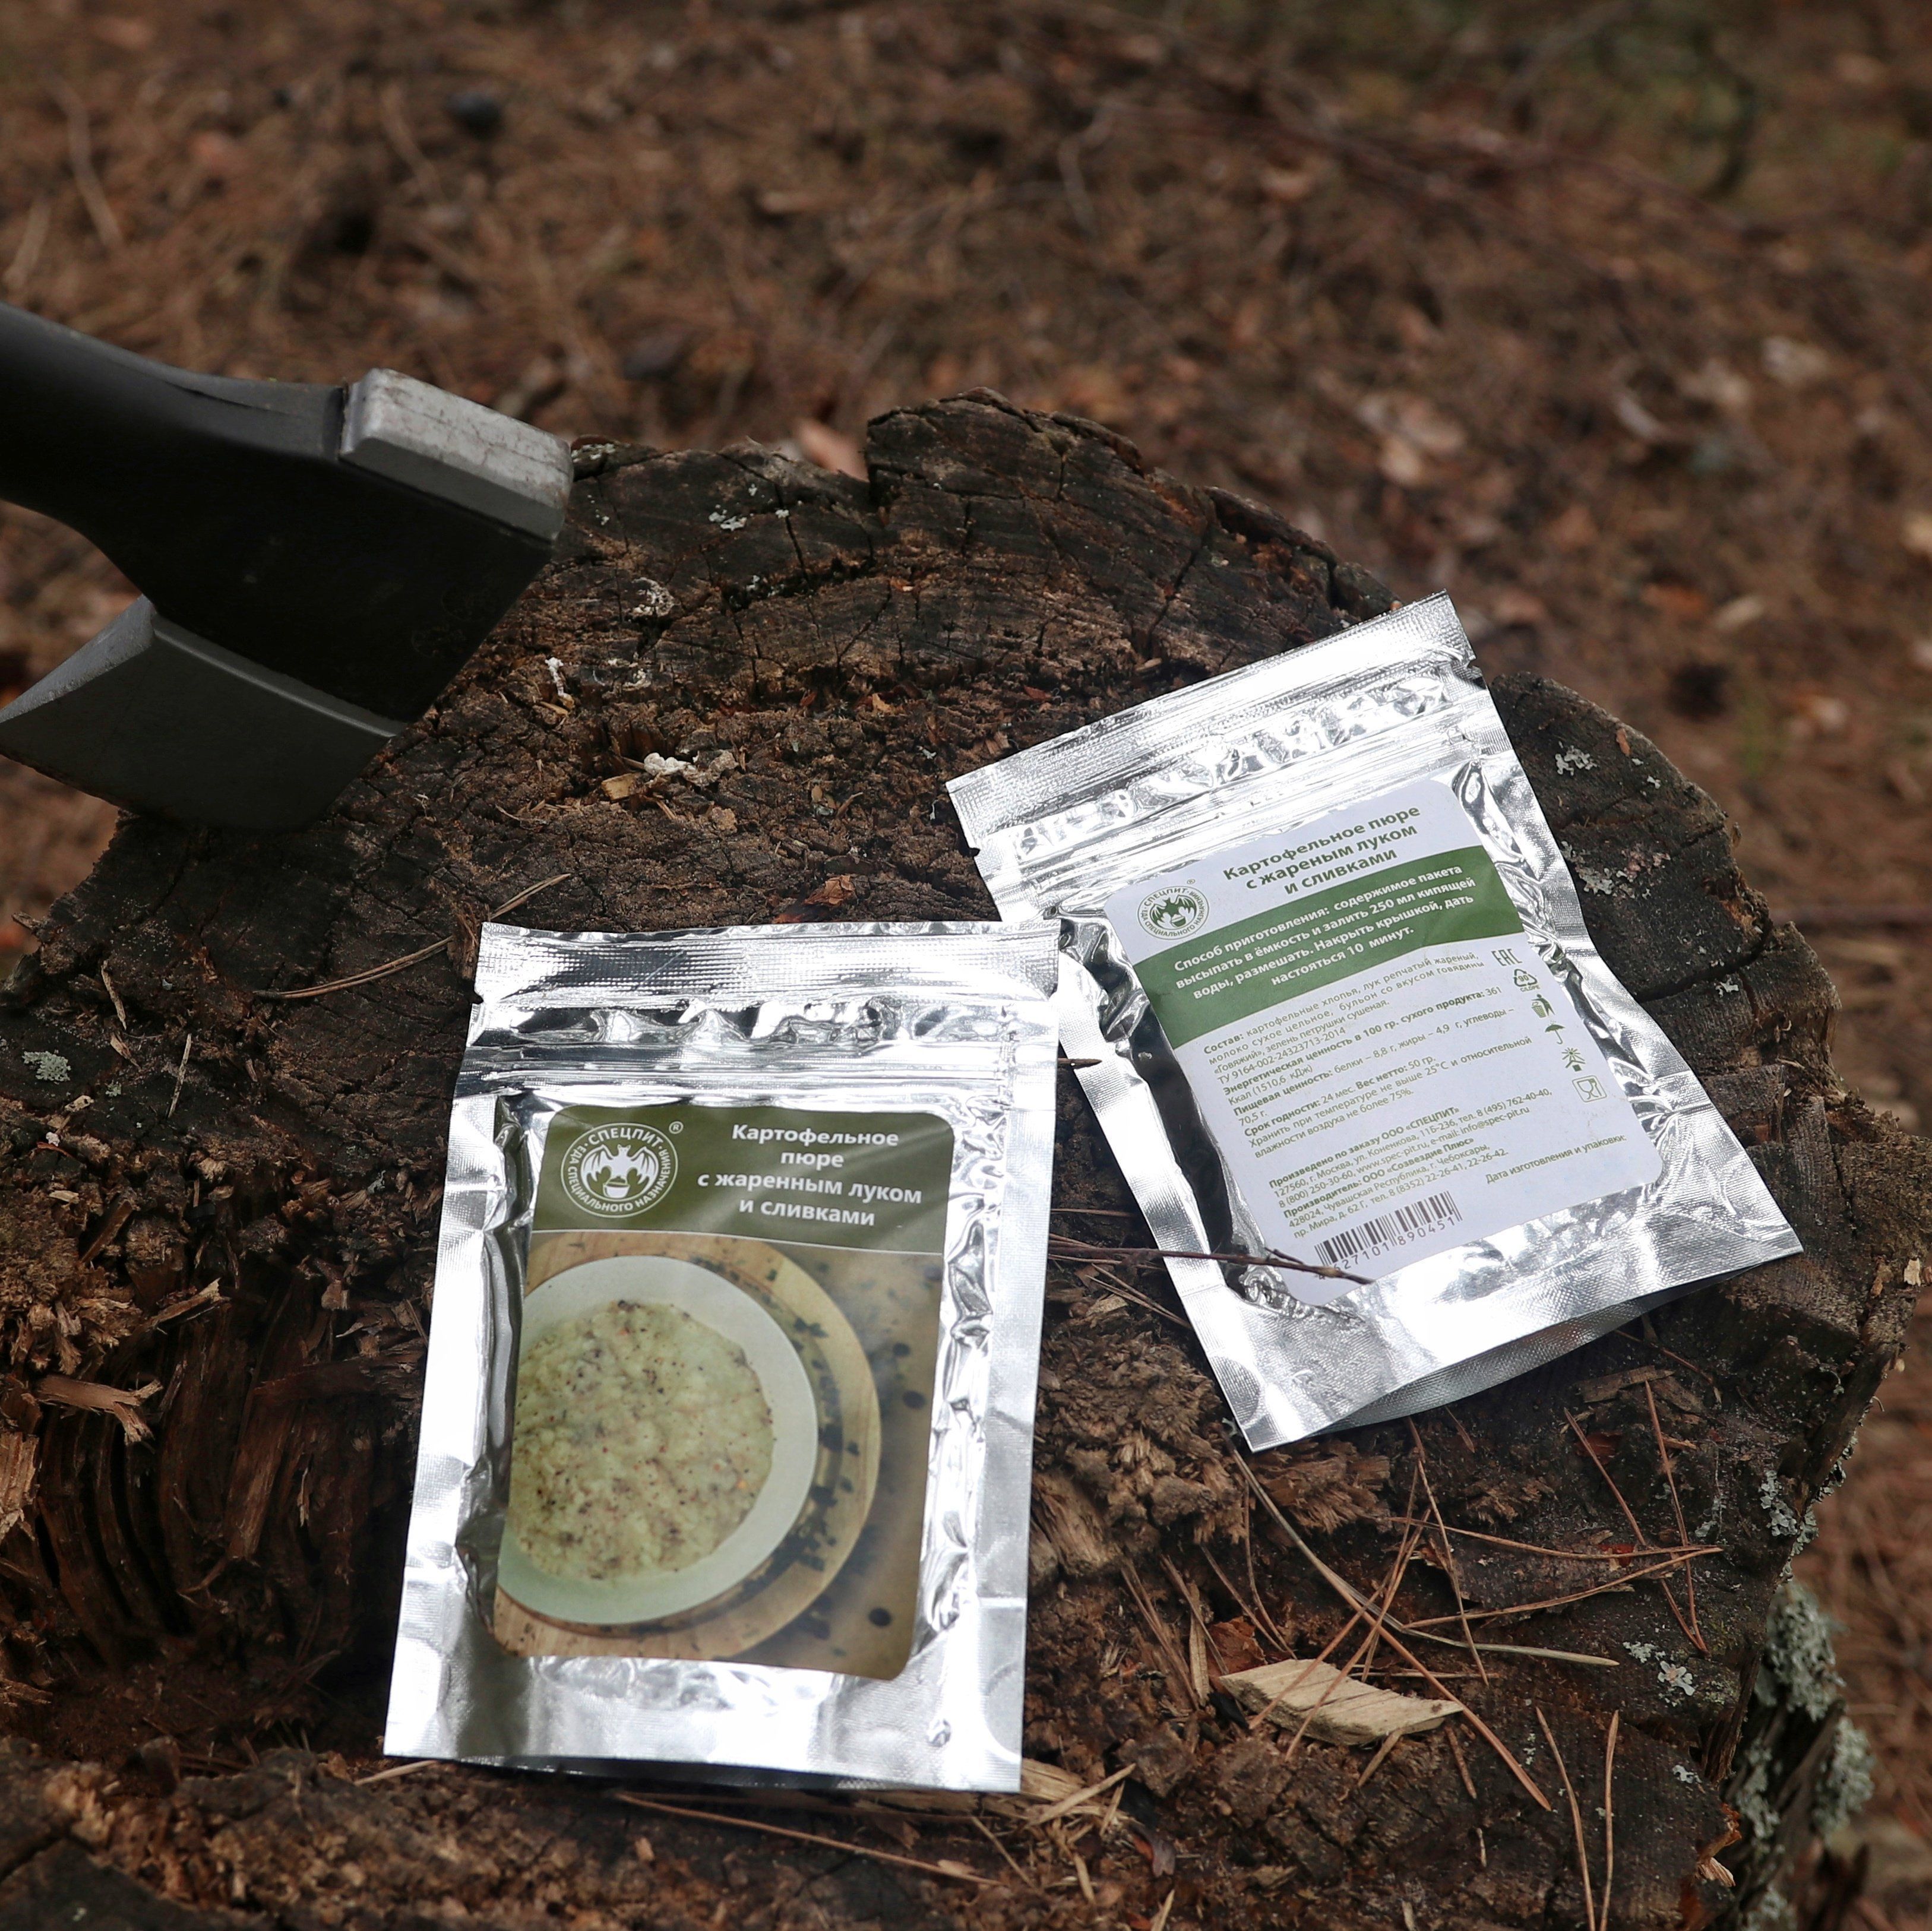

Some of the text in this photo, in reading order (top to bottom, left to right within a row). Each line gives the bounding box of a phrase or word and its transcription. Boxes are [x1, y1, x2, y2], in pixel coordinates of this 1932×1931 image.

[1222, 807, 1420, 880] Картофельное пюре
[1246, 825, 1417, 889] с жареным луком
[1144, 888, 1188, 906] СПЕЦПИТ
[1283, 849, 1397, 894] и сливками
[1145, 922, 1195, 936] СПЕЦИАЛЬНОГО
[1174, 866, 1462, 971] Способ приготовления: содержимое пакета
[1175, 876, 1476, 989] высыпать в ёмкость и залить 250 мл кипящей
[1193, 895, 1473, 999] воды, размешать. Накрыть крышкой, дать
[1271, 926, 1414, 985] настояться 10 минут.
[1209, 1043, 1248, 1065] молоко
[1251, 1030, 1282, 1046] сухое
[1339, 992, 1377, 1011] бульон
[1395, 970, 1434, 989] вкусом
[1436, 961, 1484, 974] говядины
[1245, 1003, 1319, 1036] картофельные
[1362, 979, 1381, 990] лук
[1383, 957, 1432, 983] репчатый
[1222, 1057, 1304, 1096] Энергетическая
[1305, 1039, 1352, 1061] ценность
[1362, 1024, 1381, 1037] 100
[1400, 1006, 1434, 1023] сухого
[1485, 986, 1501, 996] 361
[1265, 1036, 1298, 1052] зелень
[1299, 1016, 1345, 1039] петрушки
[1228, 1091, 1252, 1106] Ккал
[1289, 1064, 1313, 1079] кДж)
[1232, 1091, 1281, 1116] Пищевая
[1333, 1058, 1363, 1073] белки
[1373, 1046, 1387, 1058] 8,8
[1397, 1034, 1426, 1049] жиры
[1435, 1024, 1450, 1034] 4,9
[1462, 1009, 1507, 1027] углеводы
[1244, 1120, 1271, 1137] Срок
[1355, 1078, 1375, 1090] Вес
[1248, 1126, 1291, 1148] Хранить
[1292, 1116, 1313, 1128] при
[1314, 1089, 1378, 1119] температуре
[1395, 1072, 1422, 1087] выше
[1460, 1036, 1532, 1063] относительной
[1483, 1101, 1506, 1115] (495)
[589, 1128, 663, 1147] СПЕЦПИТ
[732, 1124, 899, 1147] Картофельное
[1238, 1112, 1259, 1126] 70,5
[1254, 1131, 1306, 1158] влажности
[1307, 1115, 1345, 1135] воздуха
[1359, 1097, 1389, 1113] более
[568, 1145, 671, 1212] ЕДА СПЕЦИАЛЬНОГО НАЗНАЧЕНИЯ
[780, 1152, 844, 1171] пюре
[1268, 1156, 1333, 1188] Произведено
[1348, 1136, 1380, 1153] заказу
[1381, 1126, 1404, 1139] ООО
[1285, 1189, 1308, 1205] (800)
[1355, 1142, 1430, 1173] www.spec-pit.ru,
[1430, 1129, 1460, 1145] e-mail:
[1459, 1106, 1530, 1134] info@spec-pit.ru
[1362, 1169, 1385, 1183] ООО
[1485, 1170, 1509, 1184] Дата
[1509, 1149, 1573, 1175] изготовления
[697, 1173, 922, 1204] с жаренным луком
[739, 1199, 875, 1226] и сливками
[1323, 1186, 1374, 1211] Чувашская
[1397, 1216, 1456, 1246] 890451
